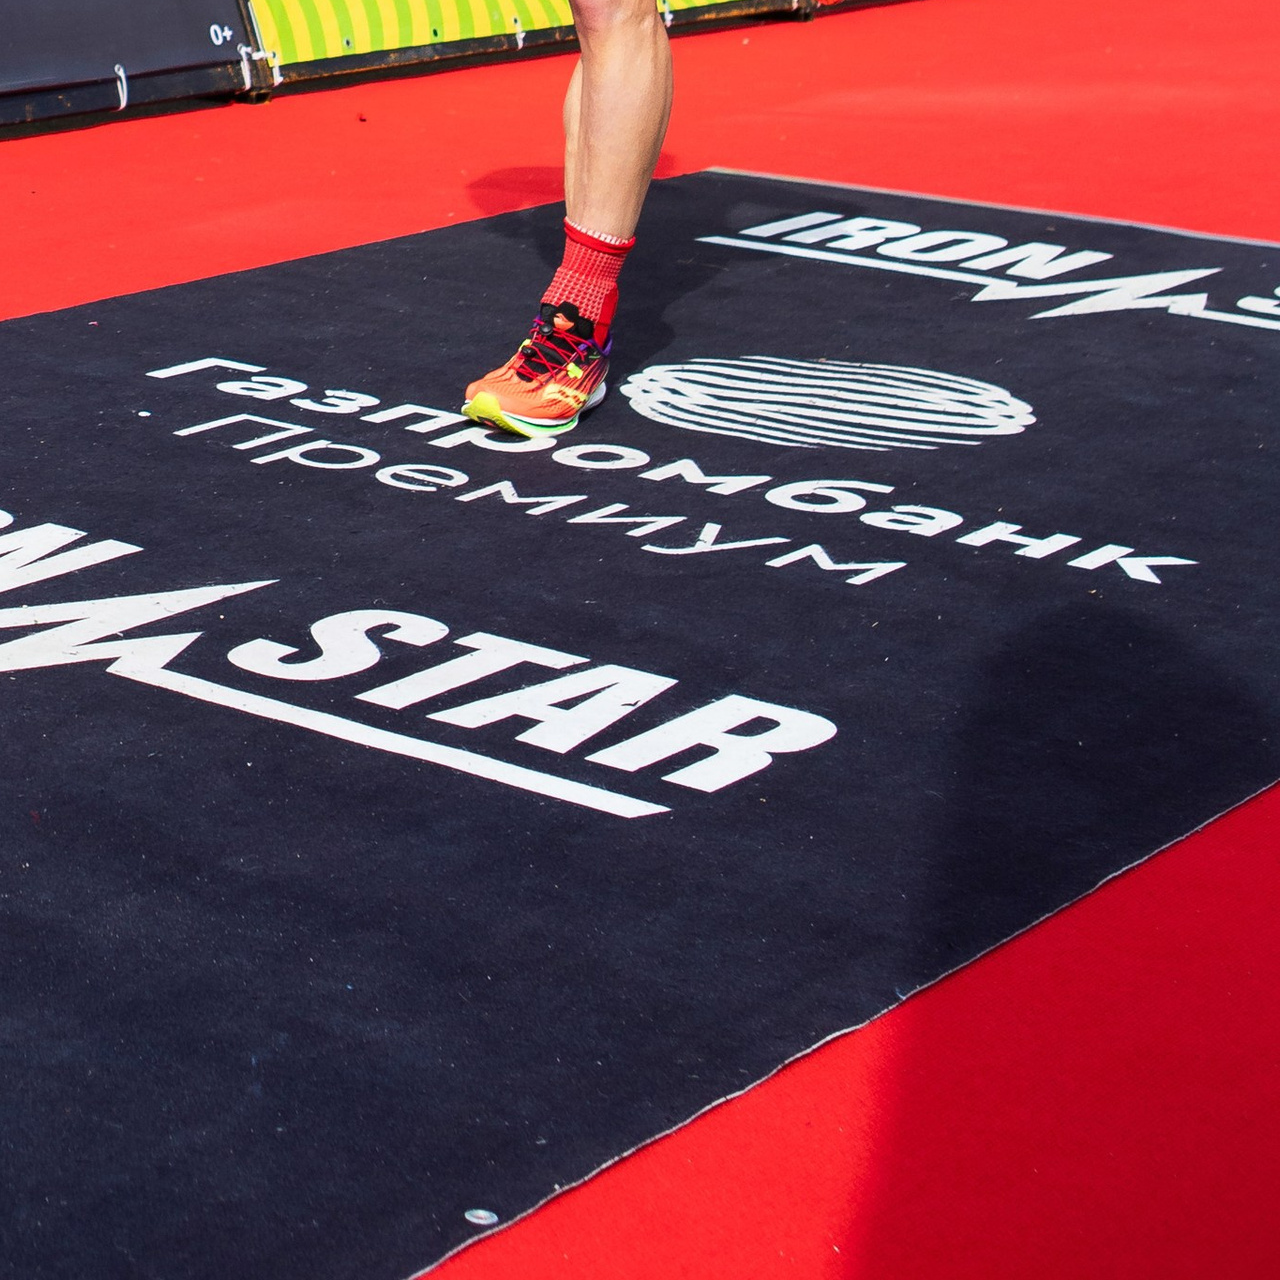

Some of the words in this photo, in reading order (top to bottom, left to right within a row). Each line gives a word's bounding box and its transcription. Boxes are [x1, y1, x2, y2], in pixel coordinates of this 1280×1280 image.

[210, 24, 233, 46] 0+
[738, 211, 1114, 279] IRON
[145, 357, 1201, 585] Газпромбанк
[173, 414, 907, 586] Премиум
[227, 609, 837, 793] STAR
